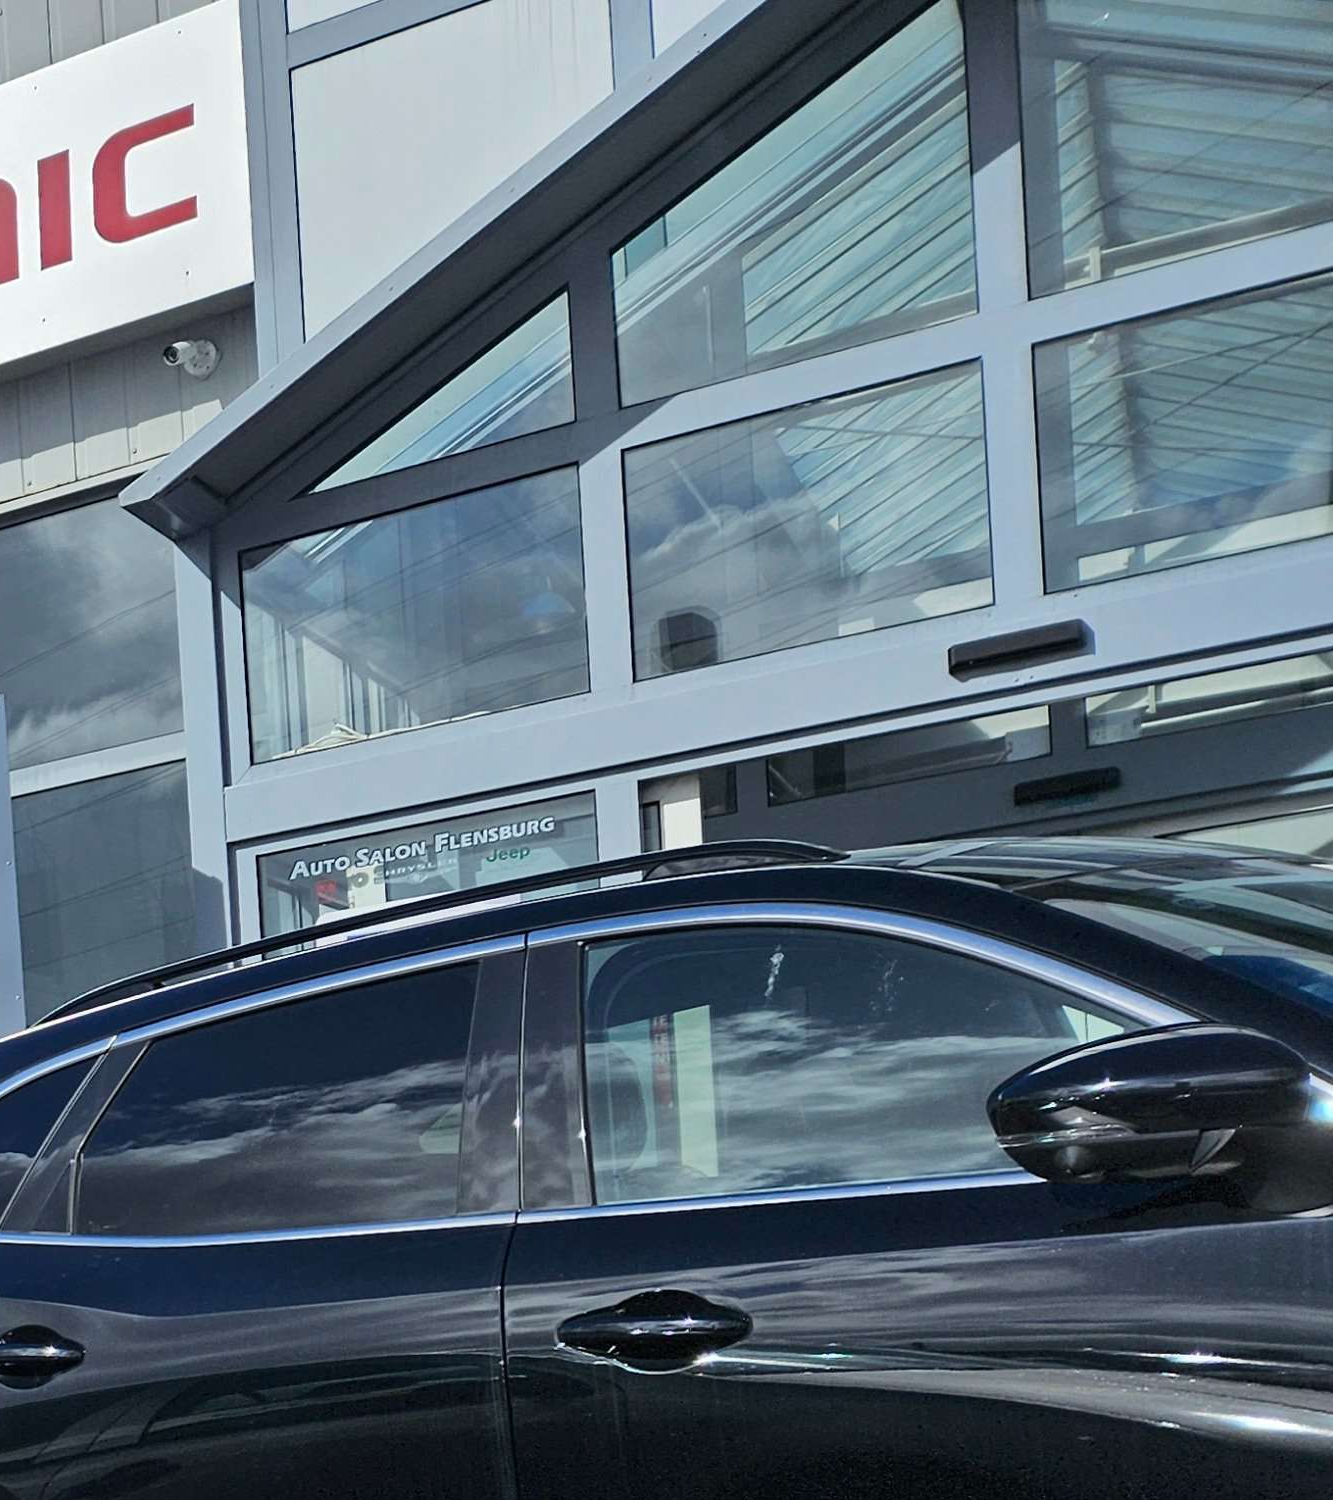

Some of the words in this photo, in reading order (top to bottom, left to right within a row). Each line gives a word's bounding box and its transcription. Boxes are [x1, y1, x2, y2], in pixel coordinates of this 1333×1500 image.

[289, 855, 351, 881] AUTO
[354, 840, 427, 868] SALON
[433, 816, 556, 853] FLENSBURG
[485, 846, 531, 864] Jeep
